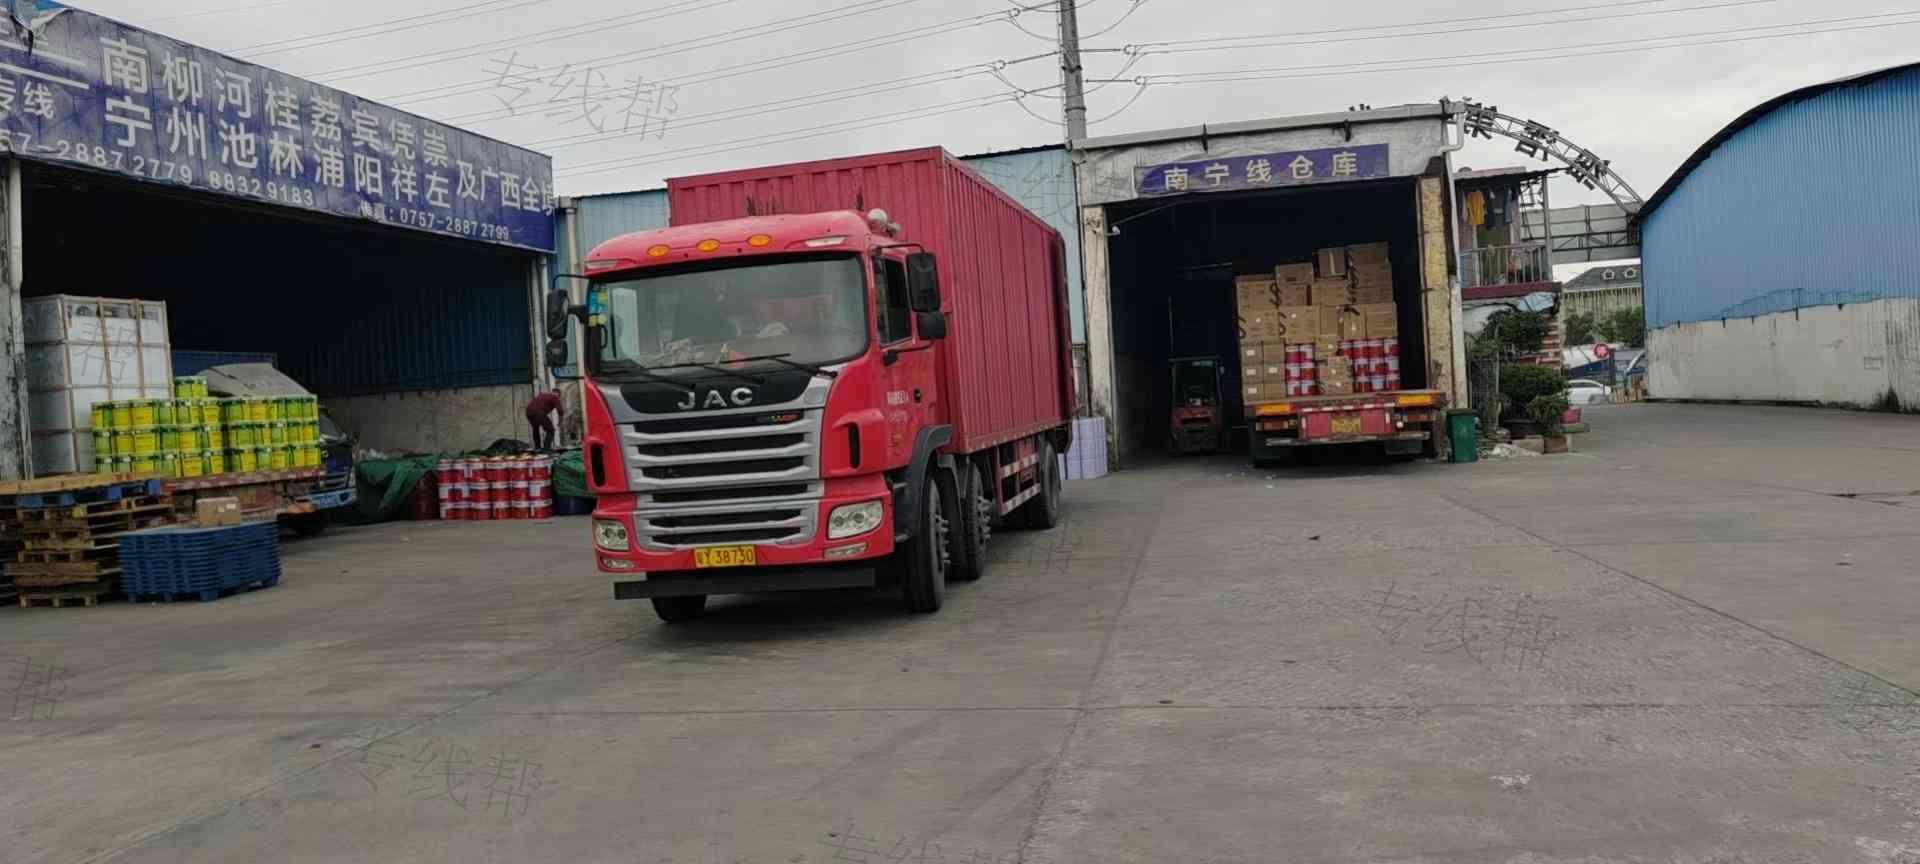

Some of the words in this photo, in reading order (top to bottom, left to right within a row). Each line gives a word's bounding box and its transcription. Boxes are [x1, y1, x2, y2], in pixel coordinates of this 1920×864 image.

[1164, 151, 1358, 191] 南宁线仓库
[677, 387, 753, 410] JAC
